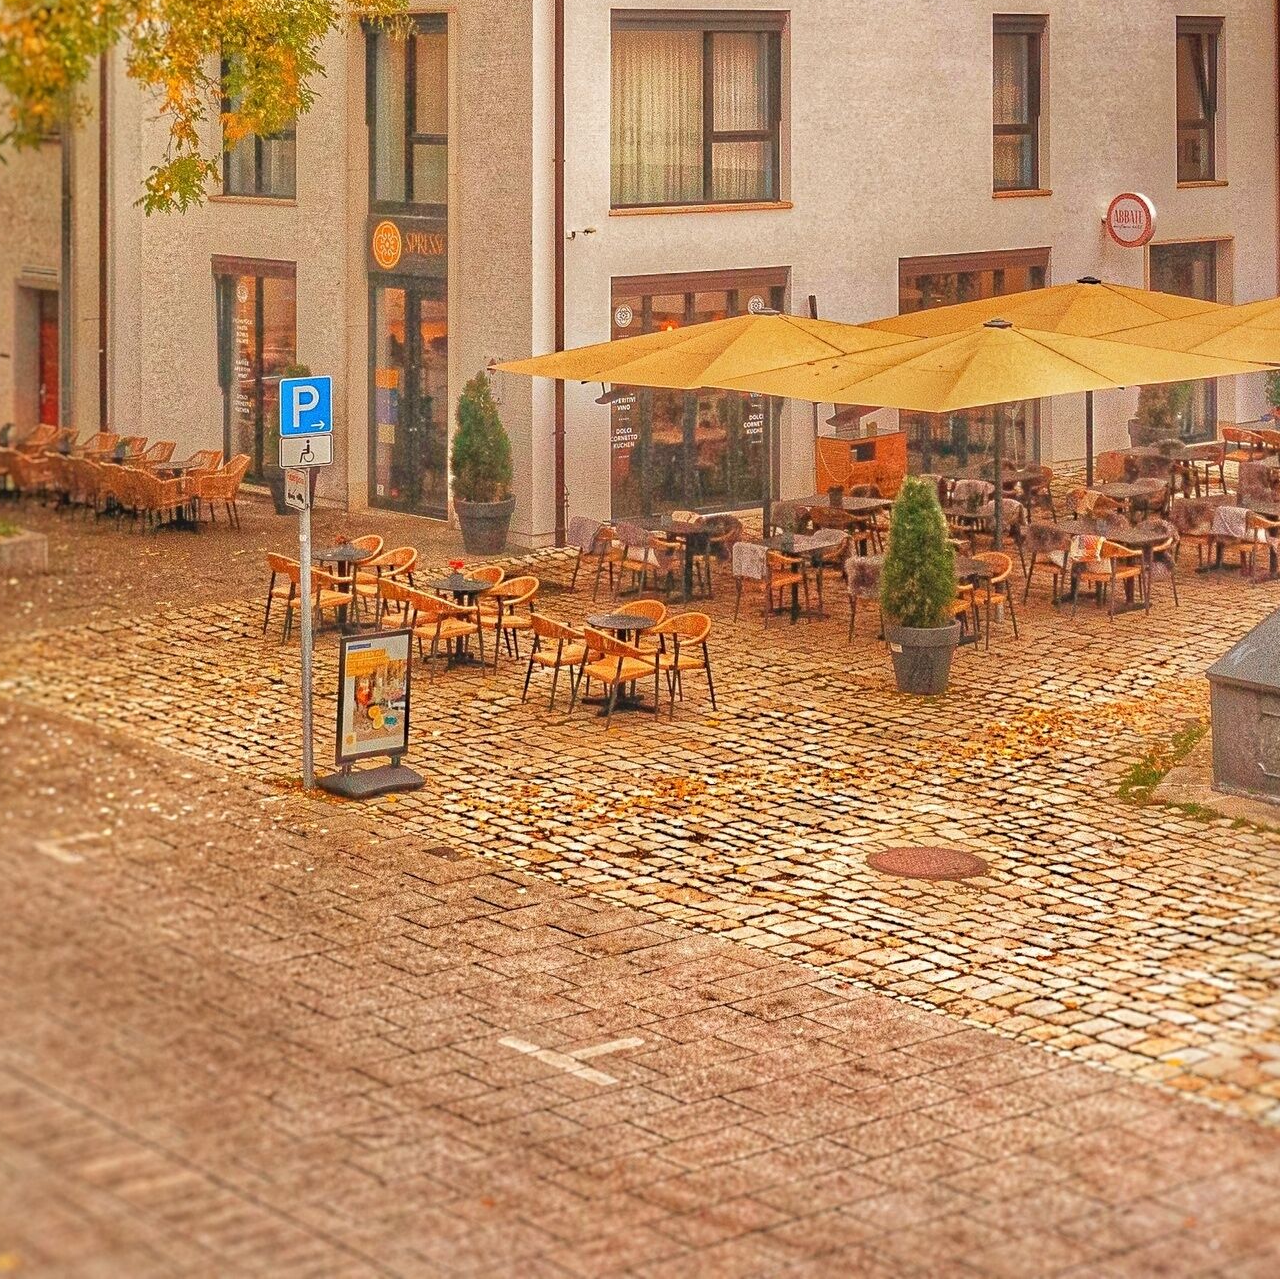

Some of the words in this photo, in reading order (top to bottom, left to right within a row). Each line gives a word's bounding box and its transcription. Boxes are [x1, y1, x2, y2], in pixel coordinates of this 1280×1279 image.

[292, 385, 320, 428] P
[743, 420, 763, 428] CORNET
[615, 427, 632, 435] DOLCI
[746, 427, 763, 435] KUCHE
[610, 433, 638, 442] CORNETTO
[613, 441, 635, 449] KUCHEN
